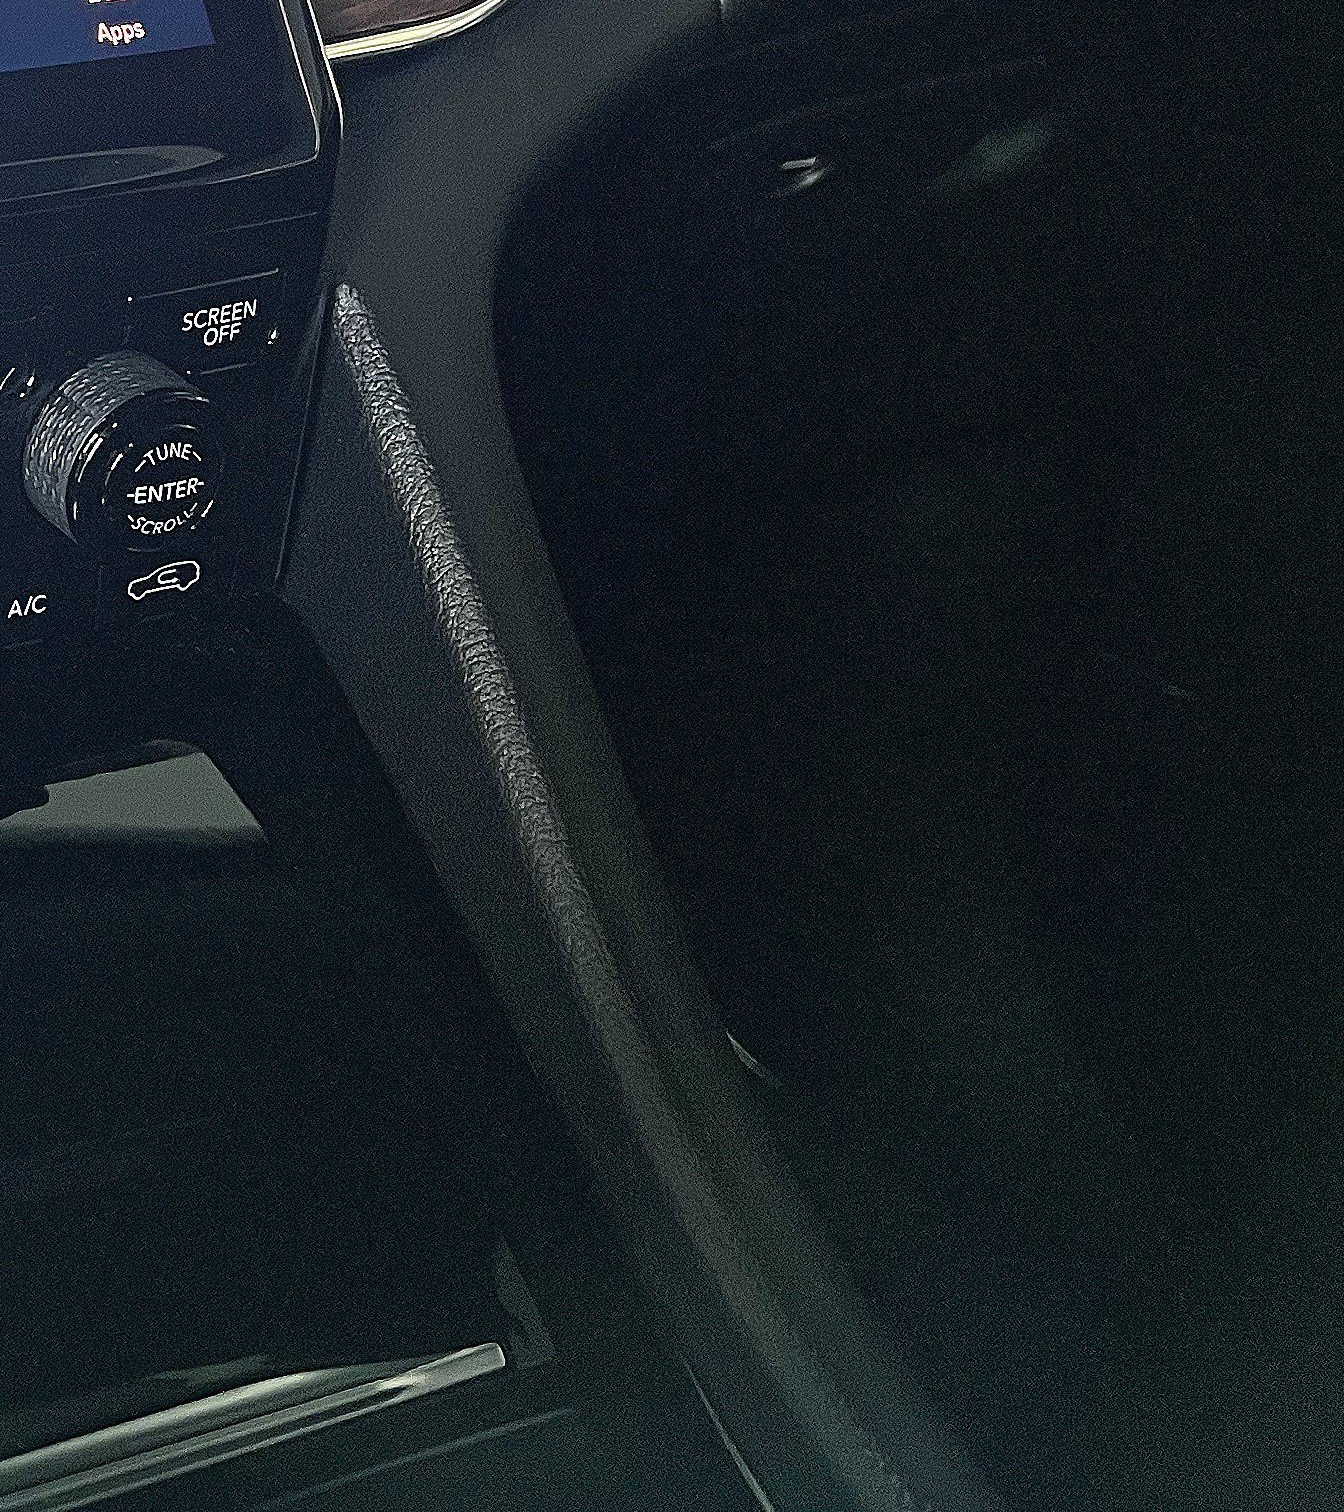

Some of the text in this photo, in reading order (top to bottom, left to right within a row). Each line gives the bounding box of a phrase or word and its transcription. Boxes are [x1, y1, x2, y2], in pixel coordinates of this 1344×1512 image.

[96, 20, 146, 45] Apps
[180, 298, 259, 332] SCREEN
[202, 321, 243, 347] OFF
[142, 441, 193, 466] TUNE
[130, 509, 195, 535] SCROLL
[7, 594, 47, 619] A/C
